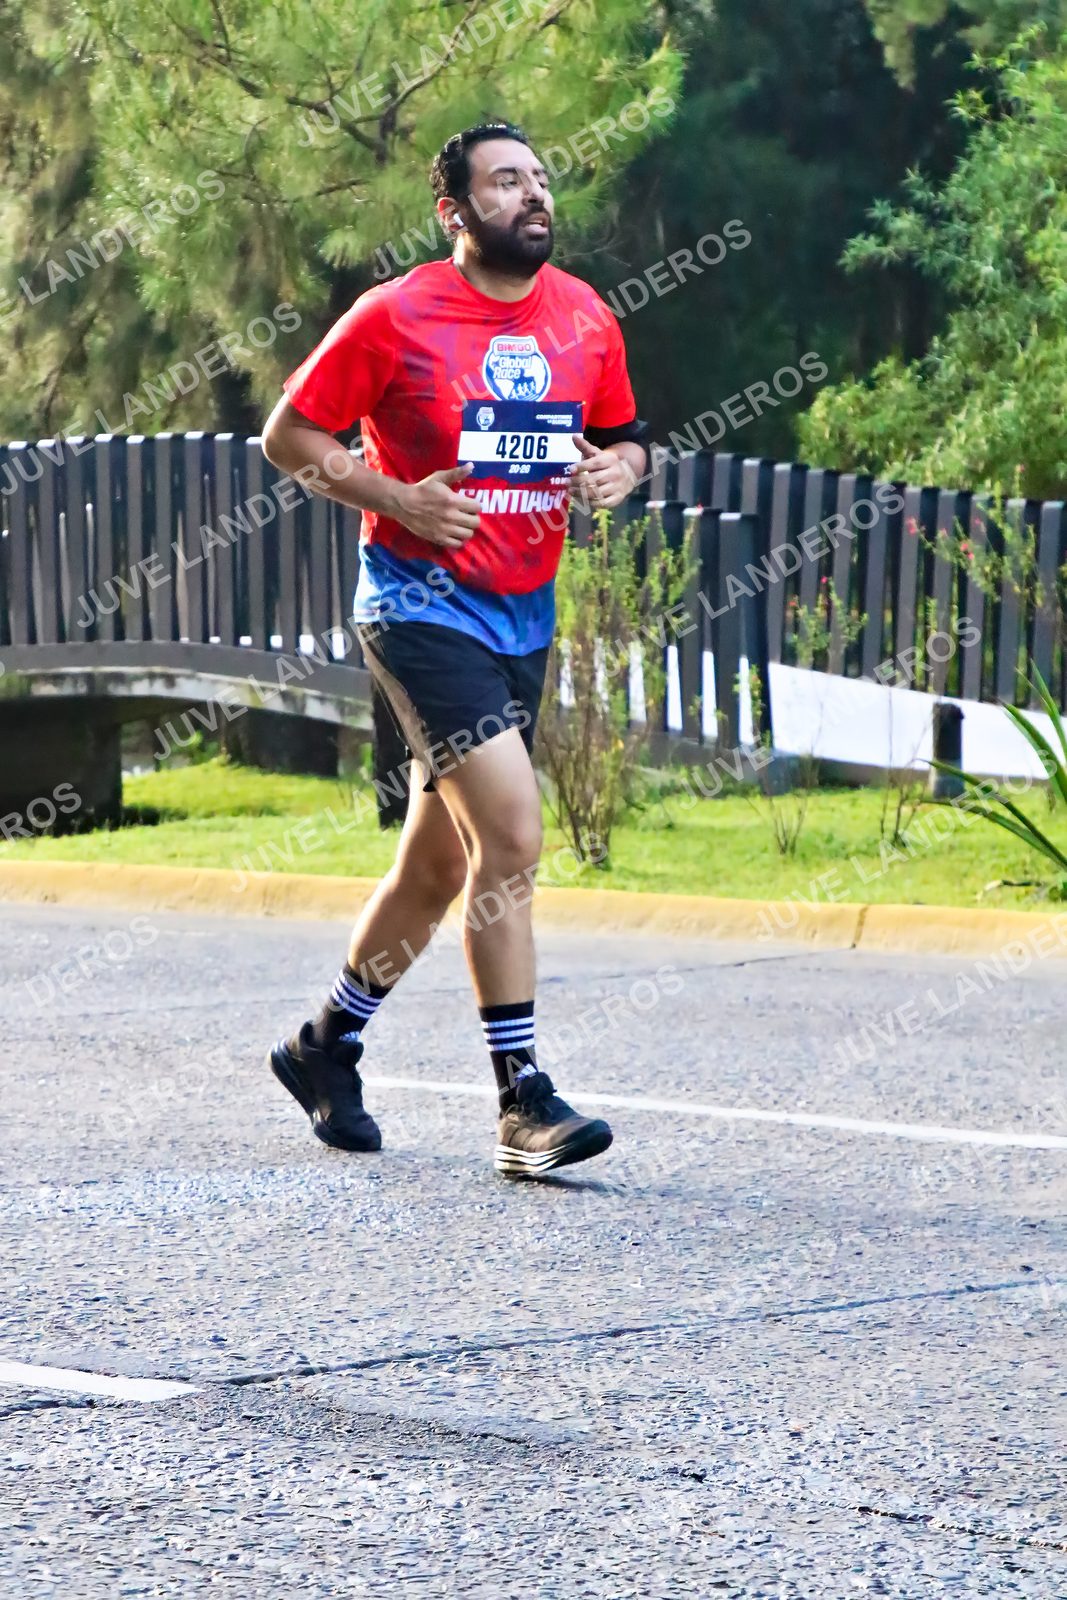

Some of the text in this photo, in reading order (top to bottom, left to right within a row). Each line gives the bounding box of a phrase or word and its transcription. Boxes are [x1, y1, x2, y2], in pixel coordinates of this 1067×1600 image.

[496, 343, 532, 352] BIMBO
[498, 355, 532, 369] Global
[493, 367, 521, 379] Race
[495, 434, 549, 460] 4206
